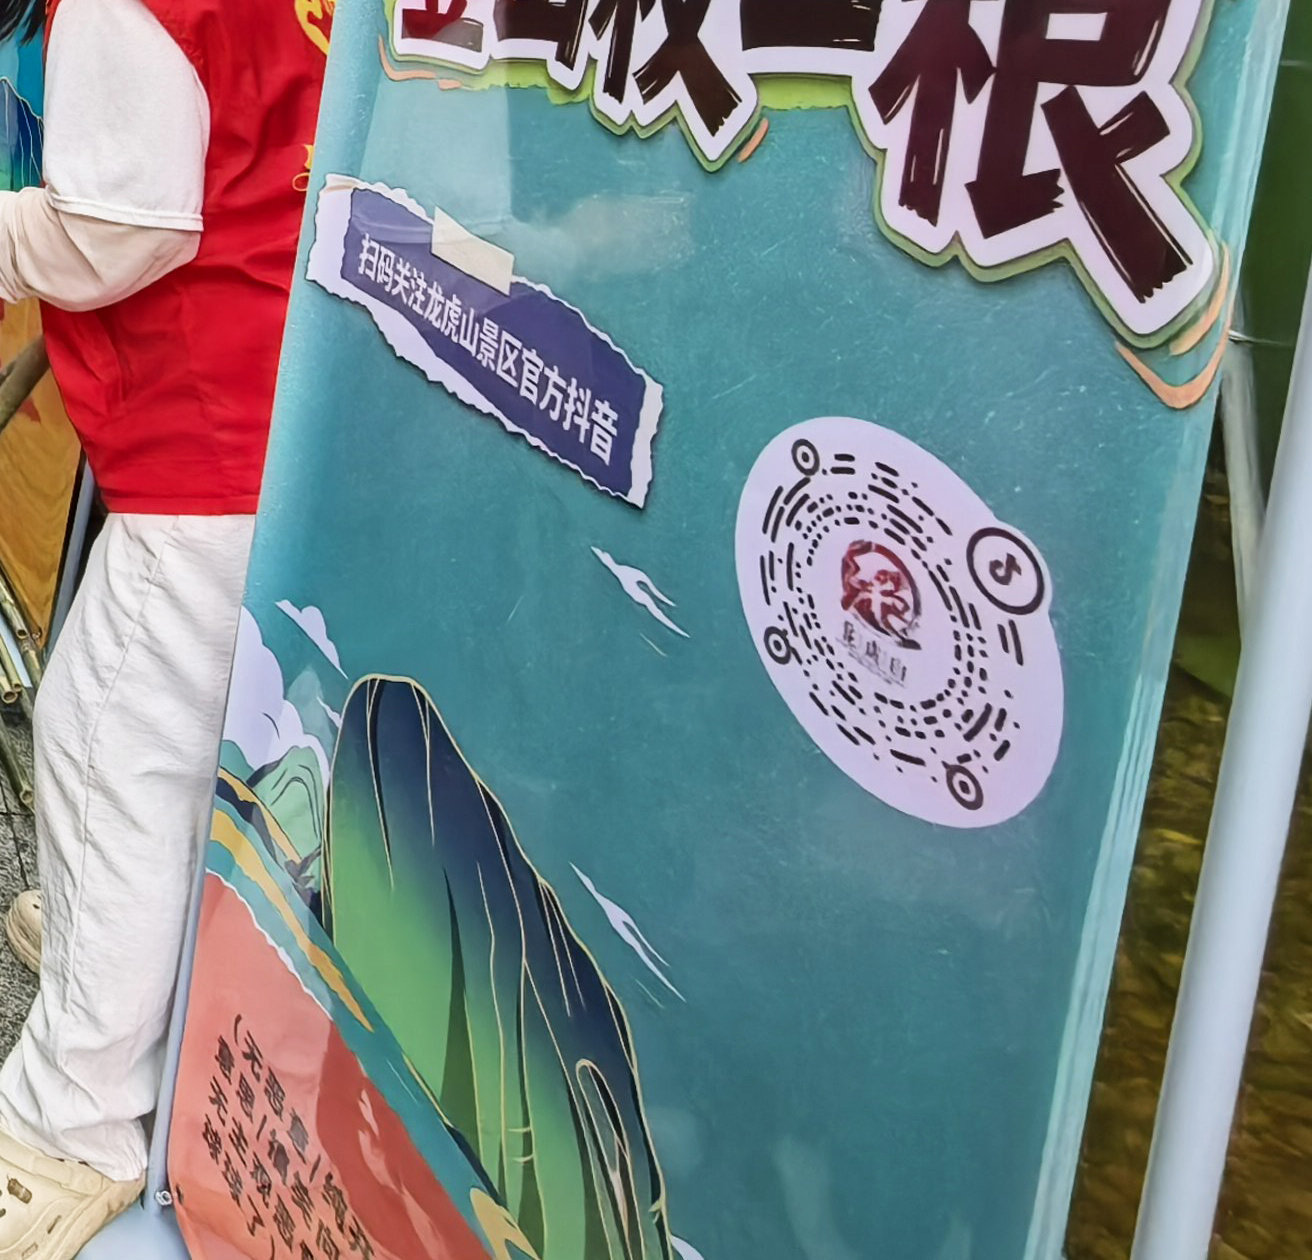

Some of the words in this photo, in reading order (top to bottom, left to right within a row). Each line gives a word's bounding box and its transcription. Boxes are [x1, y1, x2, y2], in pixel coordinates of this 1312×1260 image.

[358, 235, 618, 466] 扫码关注龙虎山景区官方抖音
